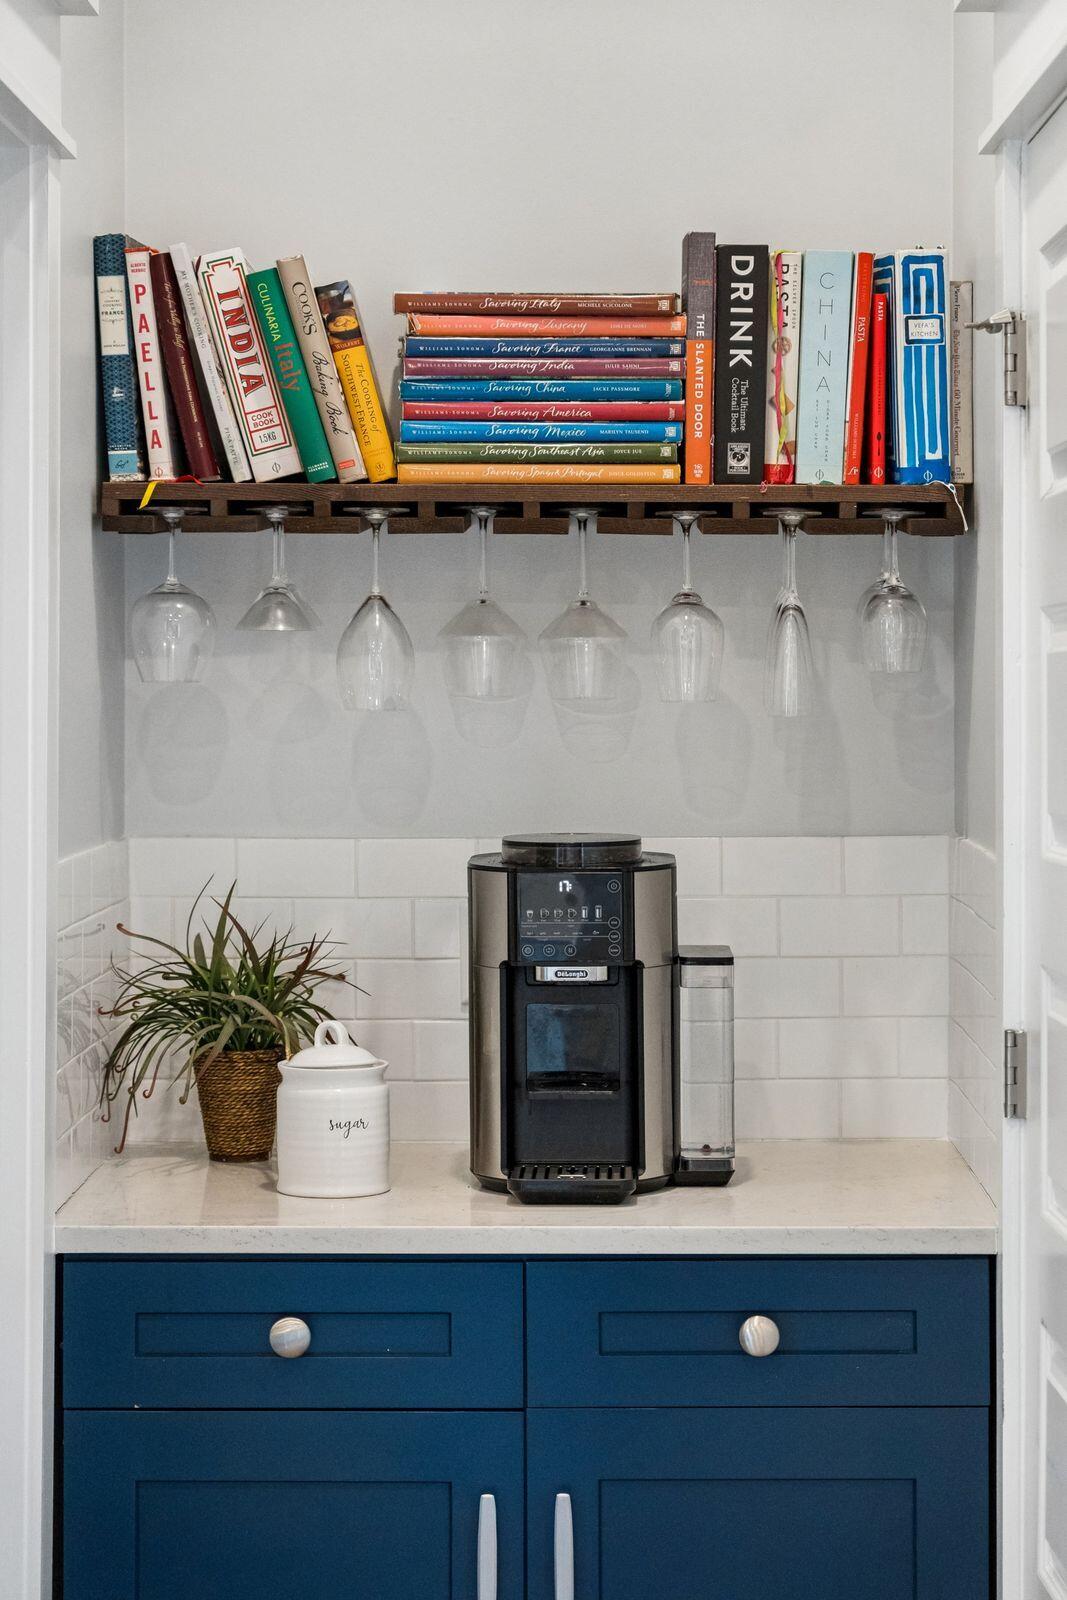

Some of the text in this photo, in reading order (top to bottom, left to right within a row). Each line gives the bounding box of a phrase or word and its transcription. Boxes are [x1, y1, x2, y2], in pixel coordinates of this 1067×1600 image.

[257, 283, 281, 342] CULINARIA
[479, 297, 528, 312] Savoring
[528, 297, 561, 312] Italy
[729, 255, 754, 367] DRINK
[491, 319, 539, 333] Savoring
[538, 318, 588, 334] Tuscany
[816, 272, 834, 392] CHINA
[857, 316, 866, 342] PASTA
[217, 287, 266, 397] INDIA
[492, 342, 541, 357] Savoring
[541, 342, 583, 354] France
[134, 283, 162, 450] PAELLA
[274, 342, 302, 391] Italy
[489, 360, 537, 374] Savoring
[537, 360, 575, 371] India
[694, 314, 705, 439] THE SLANTED DOOR
[312, 351, 336, 397] Baking
[326, 401, 348, 436] Book
[341, 353, 371, 446] SOUTHWEST FRANCE
[355, 363, 365, 379] The
[360, 377, 376, 422] COOKING
[484, 381, 531, 396] Savoring
[535, 381, 566, 393] China
[251, 410, 273, 422] COOK
[488, 405, 540, 421] Savoring
[542, 405, 592, 417] America
[730, 377, 740, 433] Cocktail Book
[739, 380, 749, 431] The Ultimate
[253, 418, 275, 428] BOOK
[485, 424, 539, 440] Savoring
[541, 425, 587, 438] Mexico
[259, 431, 277, 443] 1.5KG
[480, 445, 528, 459] Savoring
[528, 446, 580, 457] Southeast
[581, 446, 605, 458] Asia
[483, 465, 527, 480] Savoring
[560, 466, 603, 481] Portugal
[329, 1118, 369, 1139] sugar
